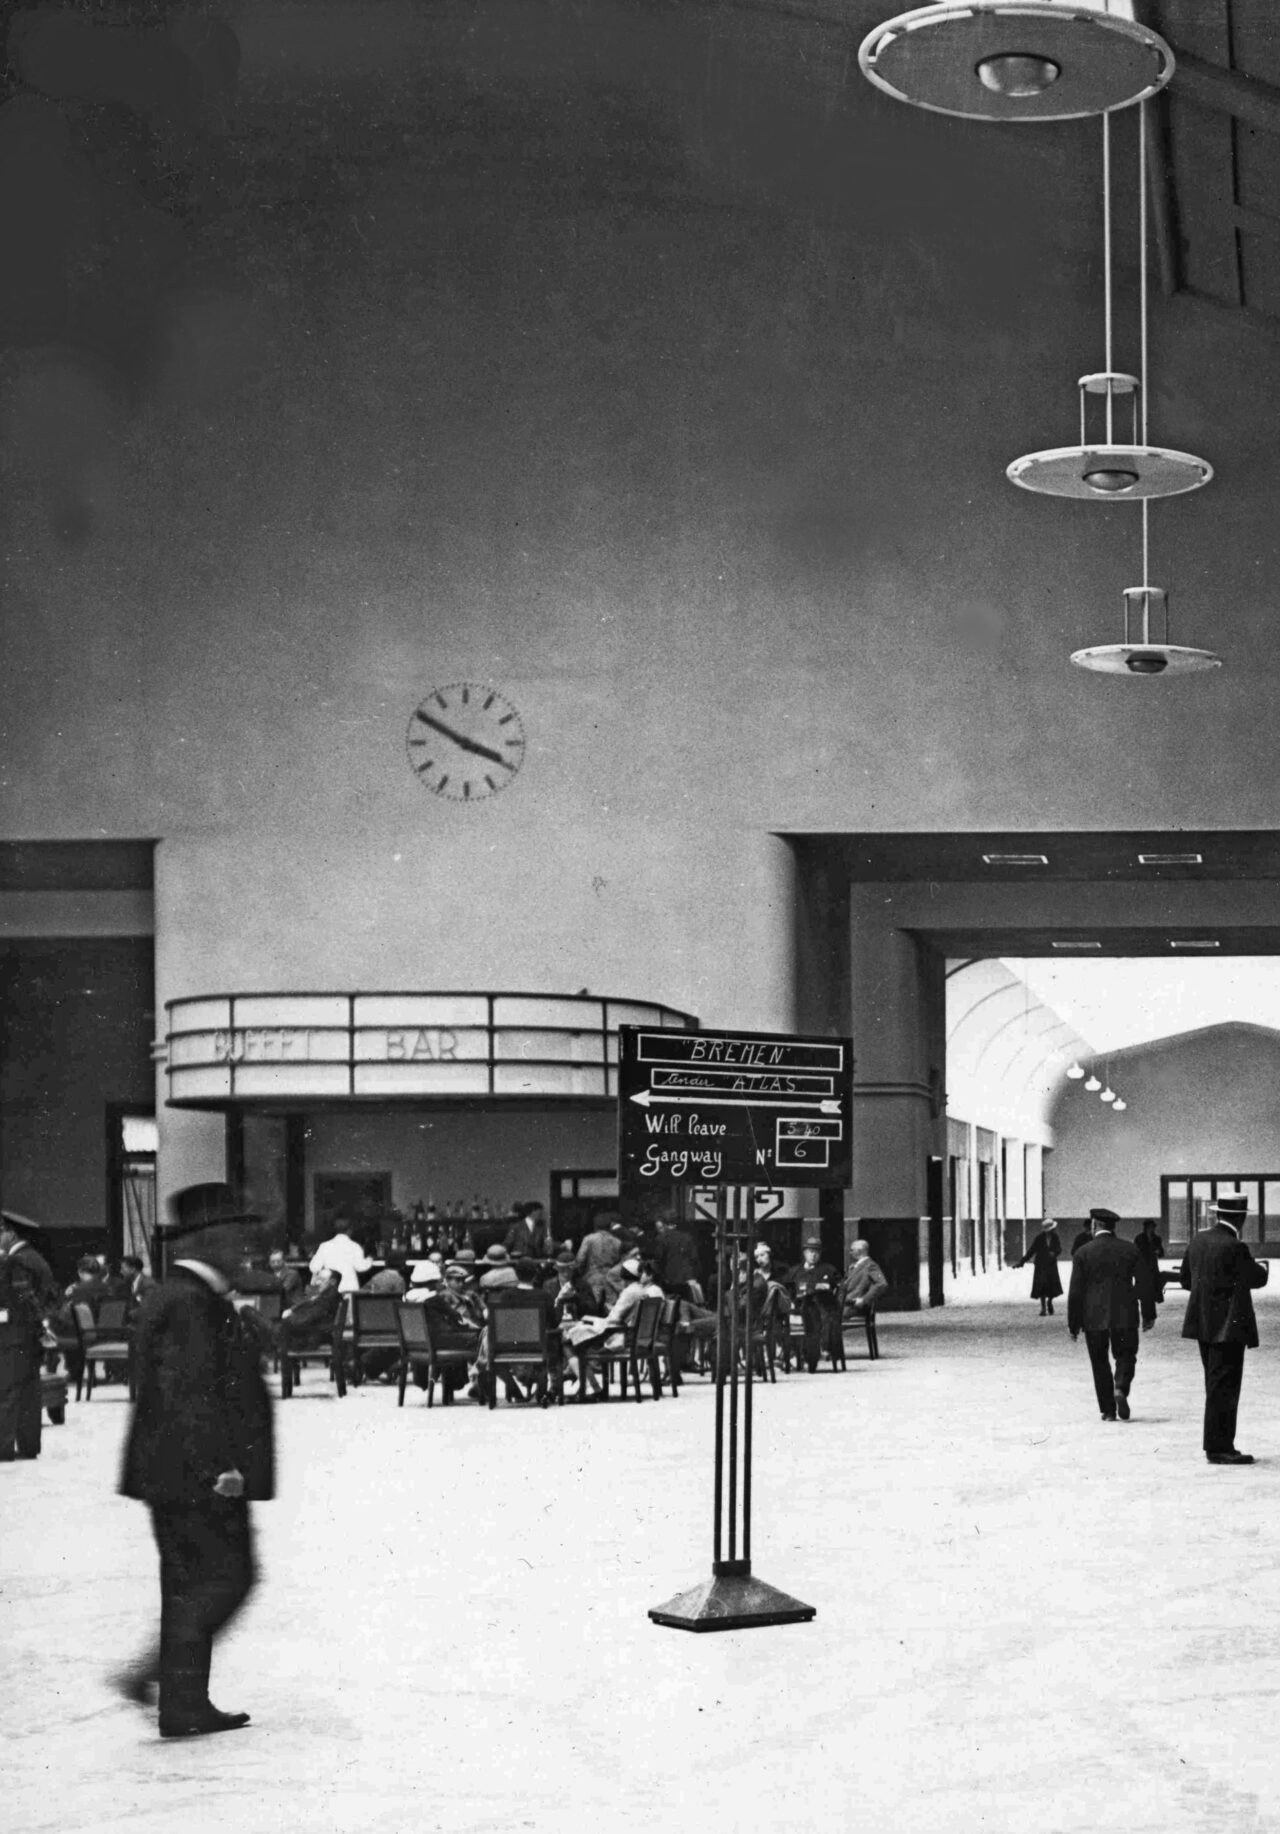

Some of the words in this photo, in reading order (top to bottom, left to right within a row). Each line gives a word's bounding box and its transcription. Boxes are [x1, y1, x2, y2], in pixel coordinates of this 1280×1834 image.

[386, 1029, 458, 1061] BAR
[645, 1113, 681, 1134] Will
[688, 1114, 727, 1136] leave
[639, 1143, 722, 1179] Gangway
[794, 1141, 807, 1158] 6
